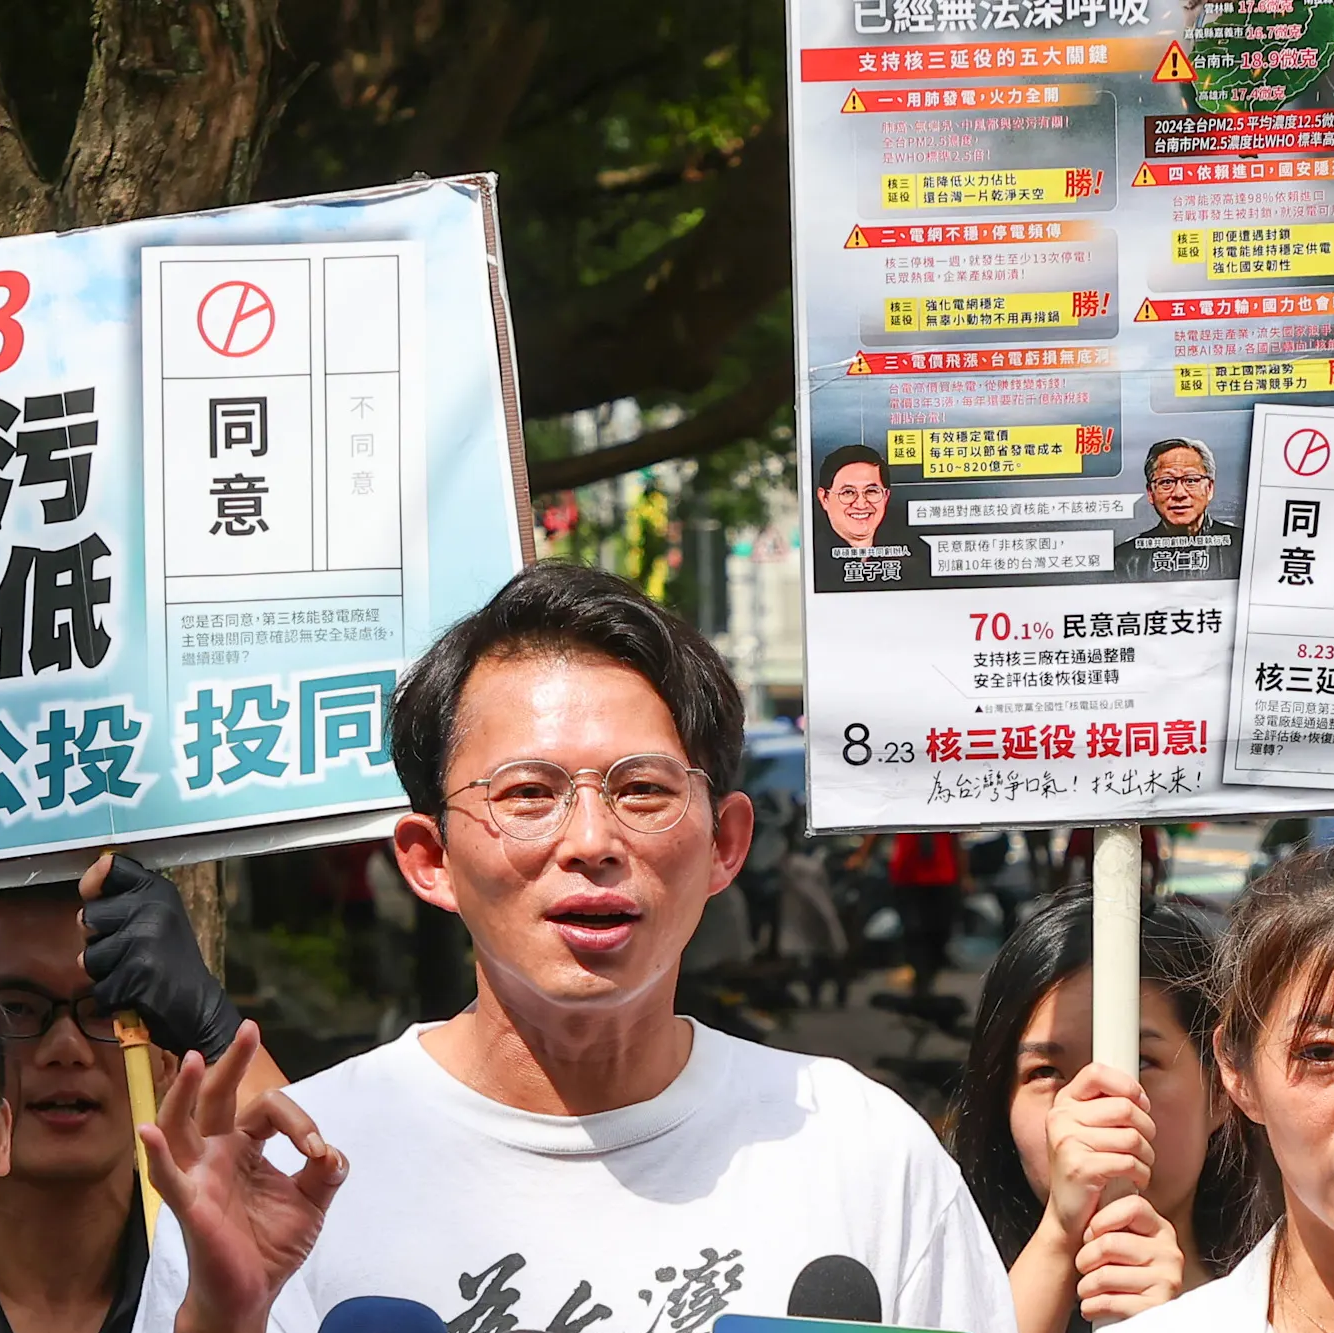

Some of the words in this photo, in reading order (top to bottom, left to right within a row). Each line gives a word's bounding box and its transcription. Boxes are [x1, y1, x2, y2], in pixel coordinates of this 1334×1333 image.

[858, 44, 1108, 72] 支持核三延役的五大關鍵
[1194, 53, 1234, 68] 台南市
[1240, 49, 1318, 69] 18.9微克
[878, 87, 1060, 107] 一、用肺發電，火力全開
[1155, 116, 1244, 134] 2024全台PM2.5
[1155, 134, 1295, 153] 台南市PM2.5濃度比WHO
[888, 178, 910, 190] 核三
[923, 175, 1017, 189] 能降低火力佔比
[1065, 168, 1104, 198] 勝!
[888, 191, 910, 202] 延役
[923, 188, 1044, 203] 還台灣一片乾淨天空
[1177, 234, 1200, 244] 核三
[1213, 228, 1291, 242] 即便遭遇封鎖
[1177, 247, 1200, 258] 延役
[1213, 242, 1332, 258] 核電能維持穩定供電
[1213, 259, 1291, 274] 強化國安韌性
[890, 301, 912, 312] 核三
[926, 297, 1006, 312] 強化電網穩定
[1072, 291, 1111, 318] 勝!
[890, 315, 912, 326] 延役
[1180, 367, 1202, 377] 核三
[1180, 380, 1202, 390] 延役
[1216, 377, 1307, 391] 守住台灣競爭力
[894, 434, 916, 445] 核三
[929, 429, 1009, 444] 有效穩定電價
[1075, 425, 1115, 455] 勝!
[350, 393, 375, 498] 不同意
[894, 447, 916, 458] 延役
[929, 444, 1063, 459] 每年可以節省發電成本
[208, 395, 269, 537] 同意
[916, 500, 1124, 519] 台灣絕對應該投資核能，不該被污名
[1278, 499, 1321, 586] 同意
[937, 555, 1100, 571] 別讓10年後的台灣又老又窮
[843, 561, 902, 582] 童子賢
[969, 612, 1054, 642] 70.1%
[1063, 608, 1223, 639] 民意高度支持
[974, 647, 1136, 668] 支持核三廠在通過整體
[1297, 644, 1334, 659] 8.23
[974, 668, 1119, 689] 安全評估後恢復運轉
[843, 722, 915, 766] 8.23
[926, 723, 1076, 763] 核三延役
[1086, 719, 1208, 759] 投同意!
[1250, 743, 1283, 756] 運轉?
